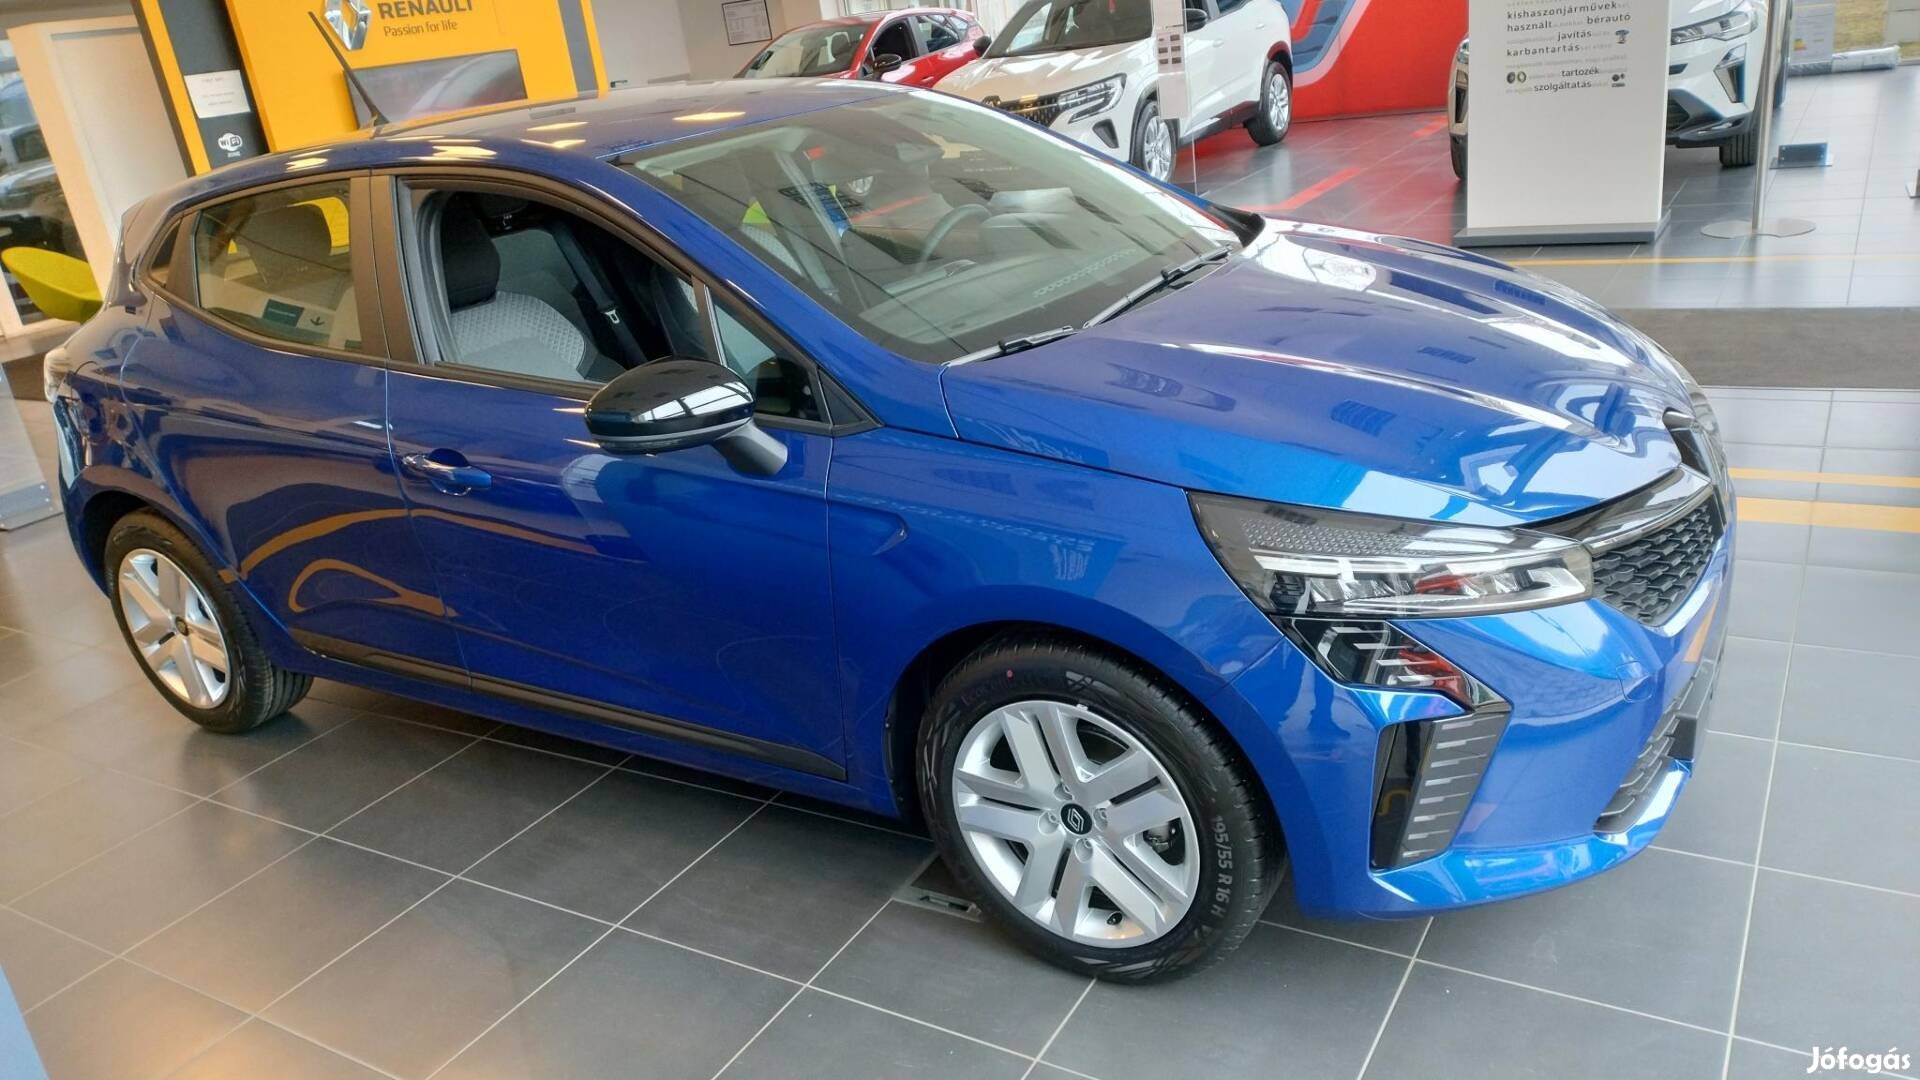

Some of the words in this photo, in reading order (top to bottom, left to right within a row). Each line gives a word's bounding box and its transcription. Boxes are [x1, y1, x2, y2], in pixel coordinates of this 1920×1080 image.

[1507, 1, 1617, 19] kishaszonjárművek
[384, 24, 424, 37] Passion
[426, 21, 440, 33] for
[442, 19, 458, 31] life
[1507, 20, 1552, 32] használt
[1587, 13, 1631, 25] bérautó
[1557, 30, 1592, 42] javítás
[1506, 44, 1580, 57] karbantartás
[1561, 66, 1600, 77] tartozék
[1534, 80, 1592, 92] szolgáltatás
[1213, 815, 1233, 870] 195/55
